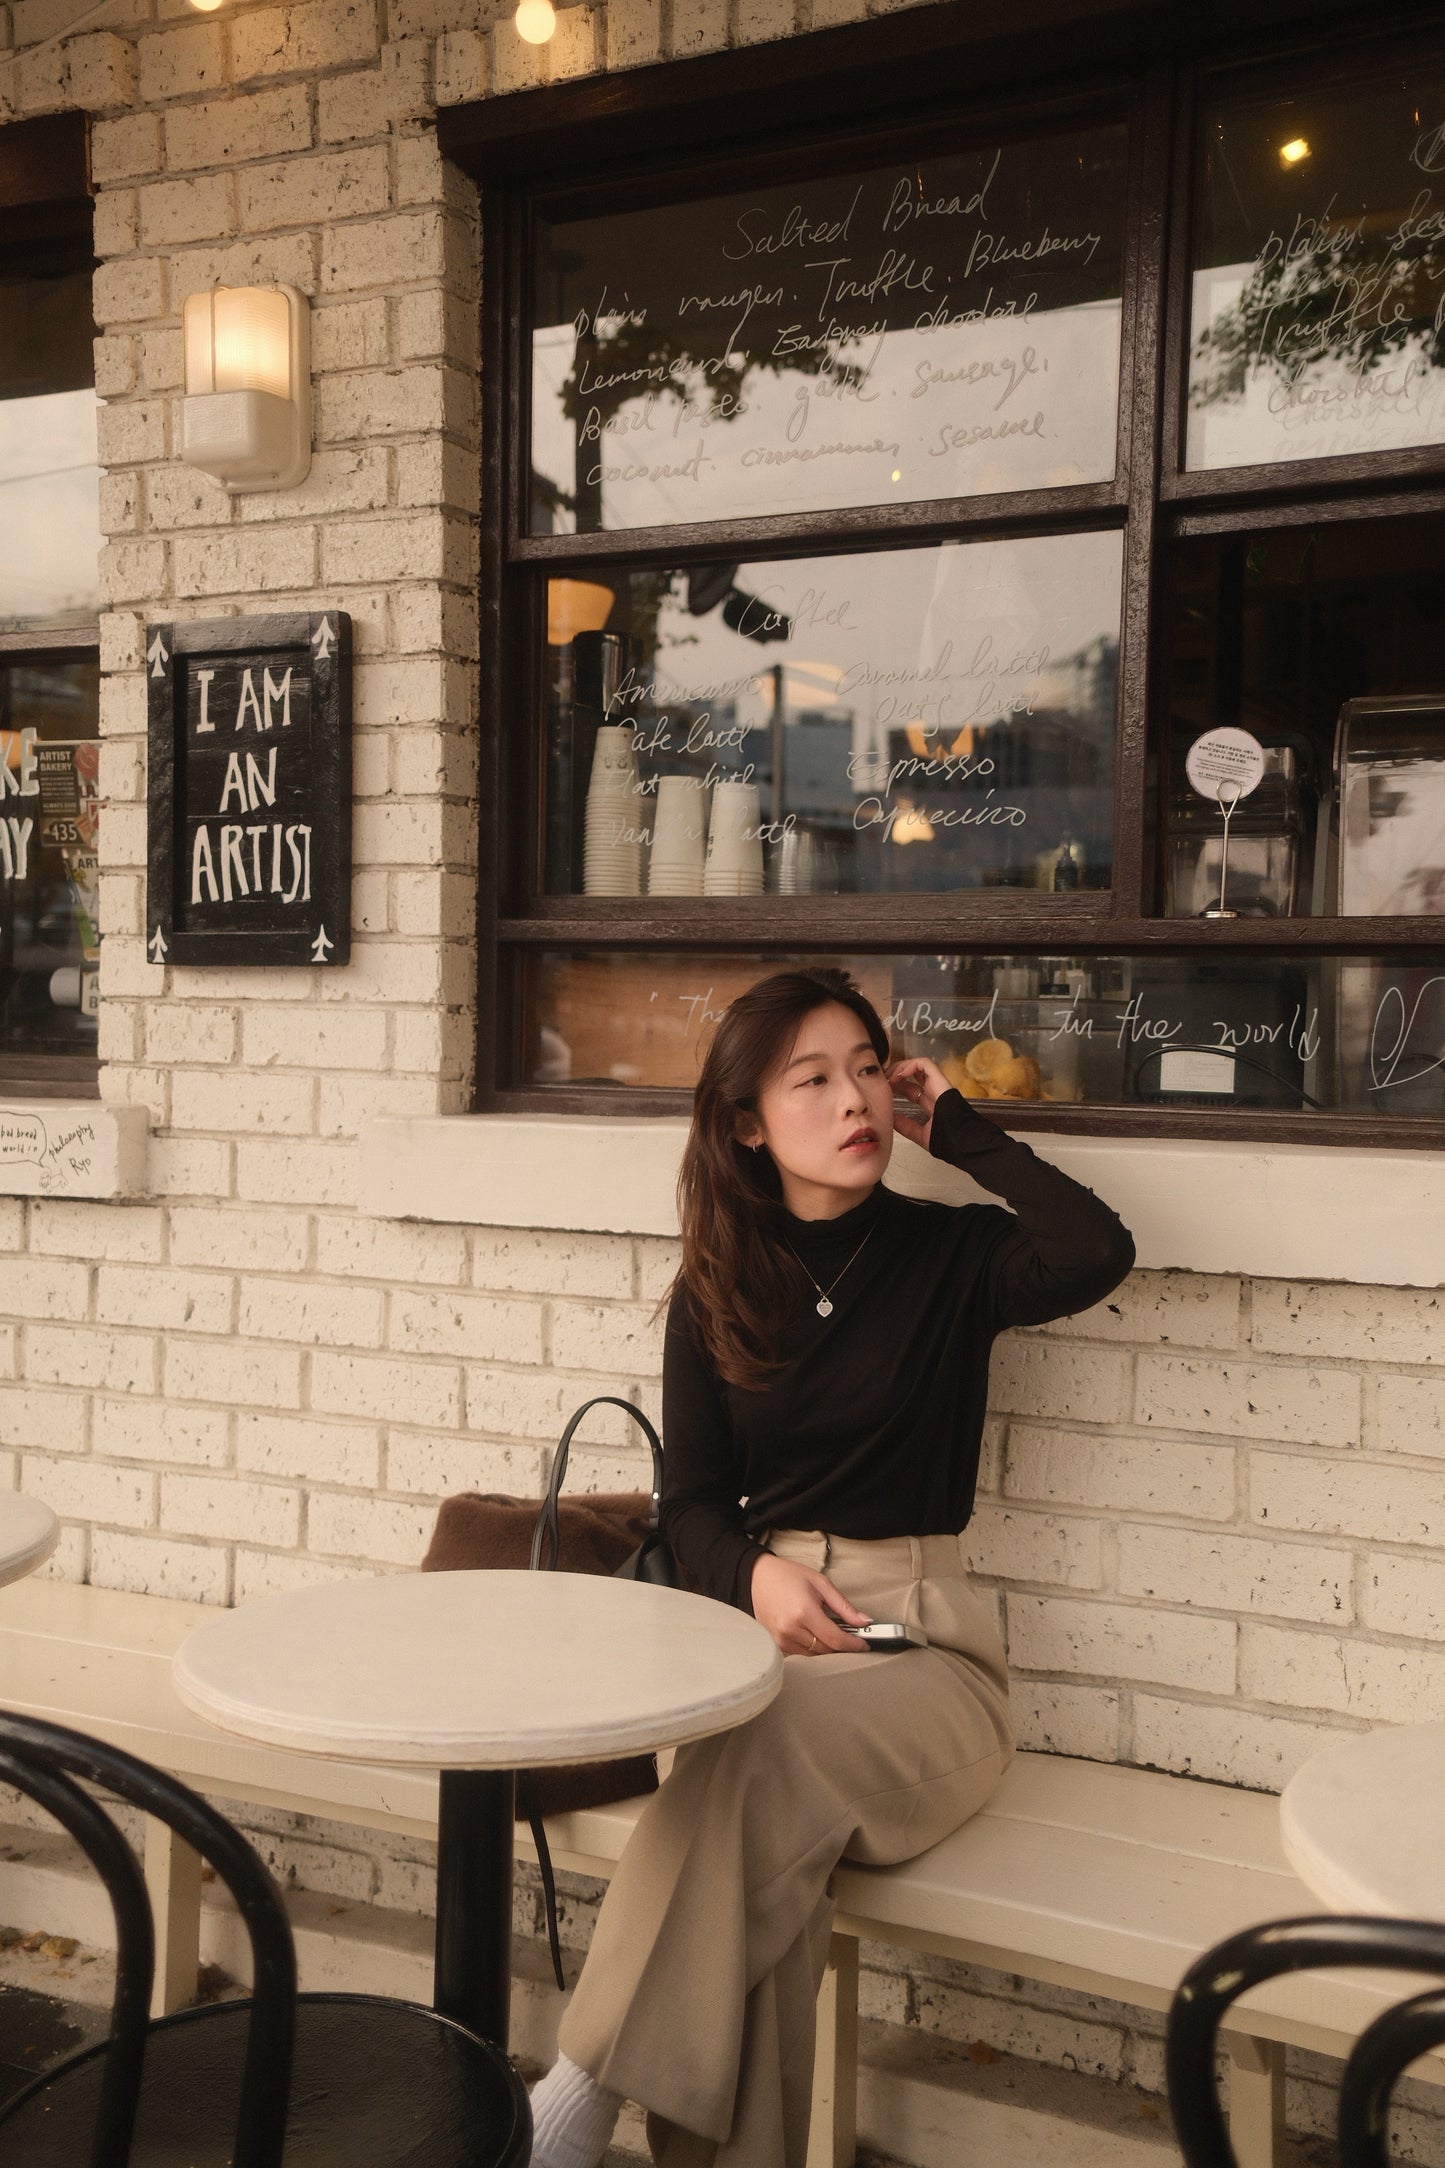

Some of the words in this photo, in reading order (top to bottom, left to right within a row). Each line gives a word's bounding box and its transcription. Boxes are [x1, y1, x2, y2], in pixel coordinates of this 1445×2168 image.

[723, 184, 863, 260] Salted
[882, 149, 1000, 232] Bread
[964, 228, 1101, 278] Blueberry
[196, 671, 215, 734] I
[235, 667, 293, 733] AM
[40, 751, 71, 761] ARTIST
[40, 762, 73, 772] BAKERY
[219, 747, 278, 814] AN
[846, 751, 996, 799] Espresso
[51, 824, 77, 841] 435
[191, 824, 312, 905] ARTIST
[1115, 992, 1183, 1049] the
[17, 1128, 37, 1140] bread
